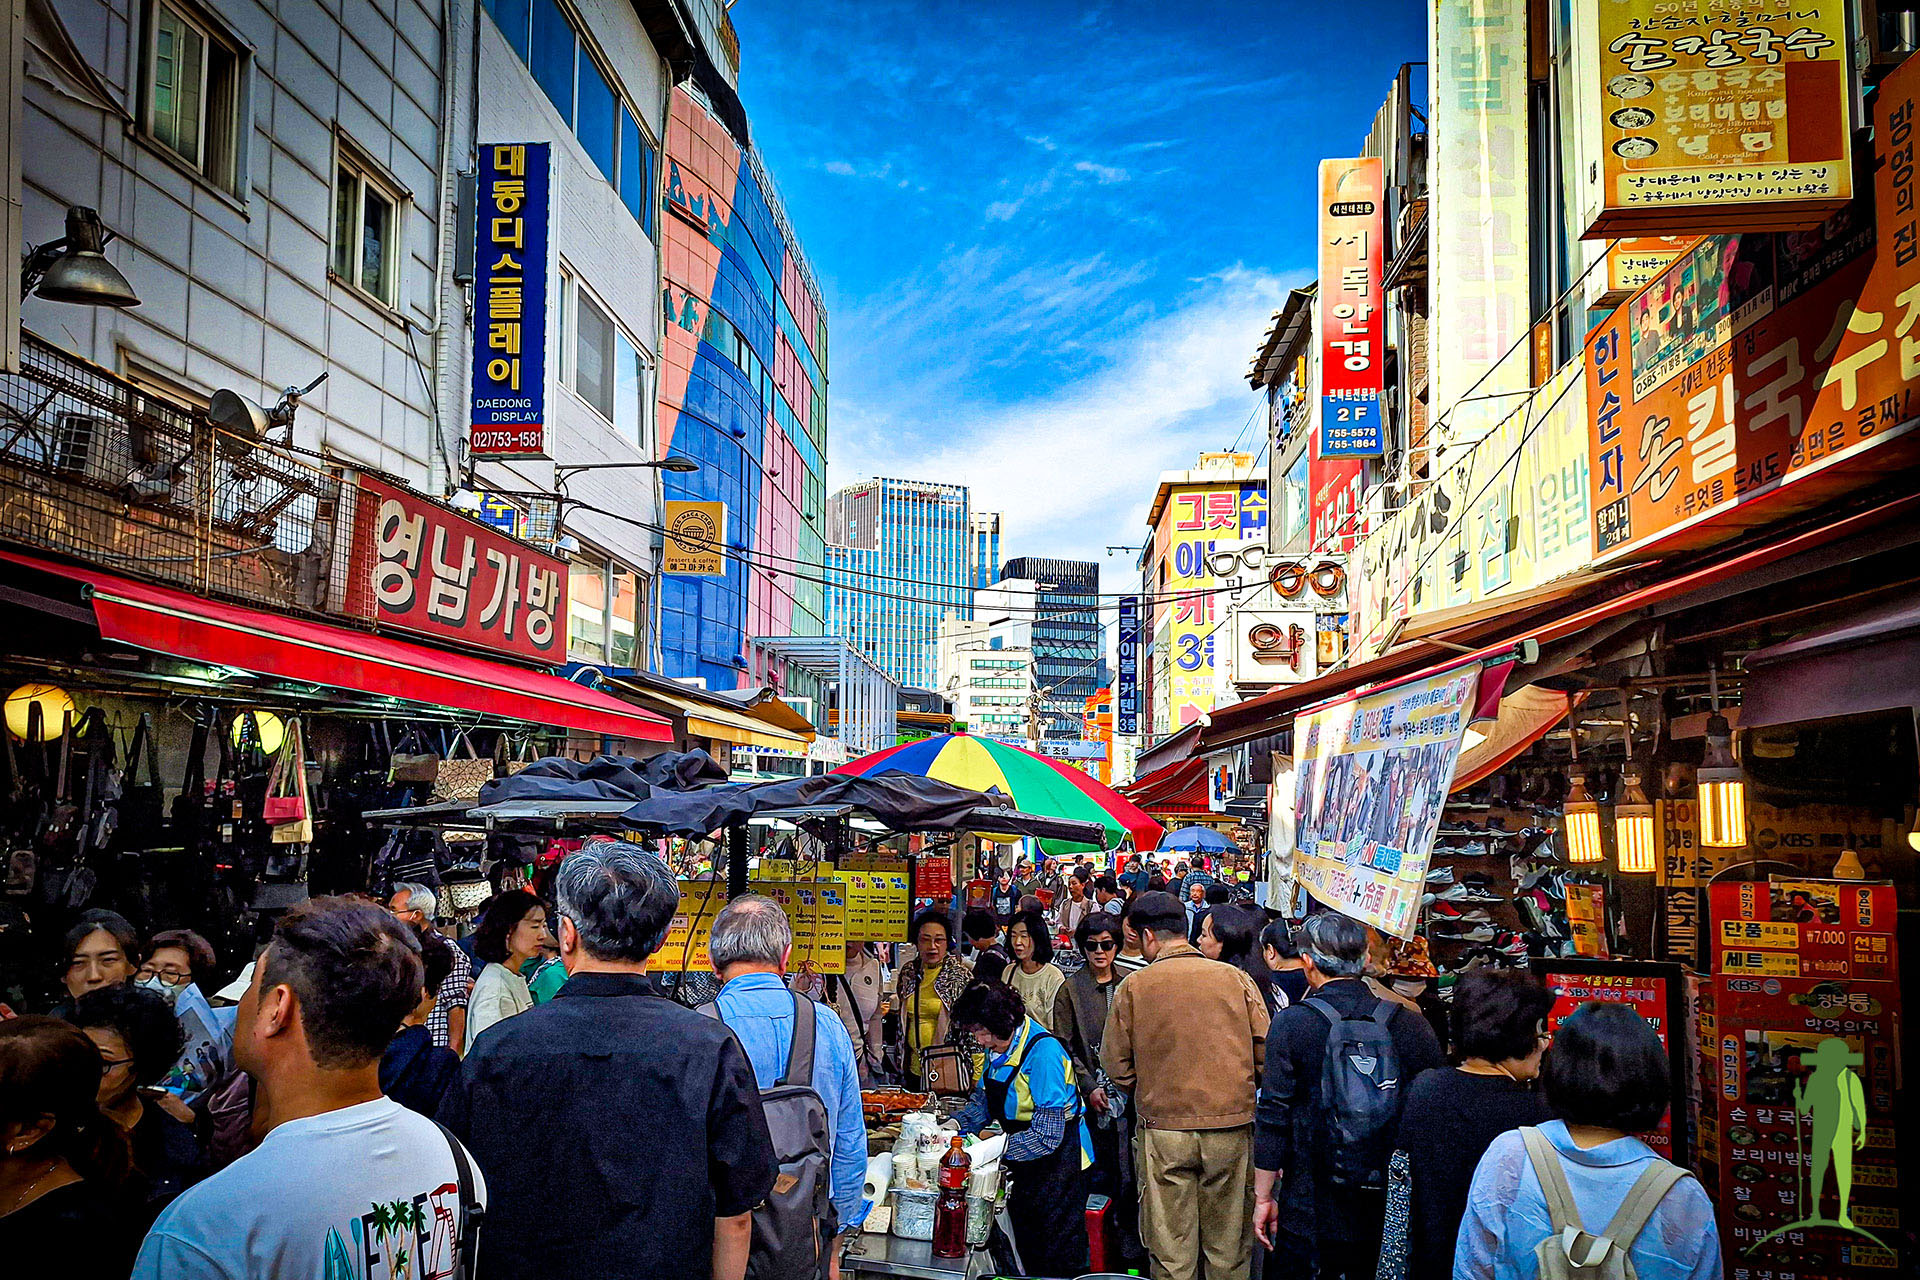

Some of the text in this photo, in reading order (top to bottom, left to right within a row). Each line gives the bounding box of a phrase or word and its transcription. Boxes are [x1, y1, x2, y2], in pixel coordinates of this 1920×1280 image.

[1629, 9, 1820, 30] 한순자할머니
[1609, 27, 1835, 72] 손칼국수
[486, 144, 526, 391] 대동디스플레이
[476, 398, 532, 409] DAEDONG
[1594, 326, 1625, 495] 한순자
[491, 411, 539, 422] DISPLAY
[473, 431, 542, 449] 02)753-1581
[1328, 427, 1377, 438] 755-5578
[1328, 437, 1377, 448] 755-1864
[1789, 421, 1846, 468] 냉면은
[1176, 492, 1237, 530] 그릇
[371, 499, 561, 645] 영남가방
[669, 563, 715, 572] 에그마카슈
[1118, 718, 1137, 732] 3층
[1052, 746, 1069, 755] 조성
[1724, 921, 1762, 938] 단품
[1725, 951, 1763, 968] 세트
[1568, 988, 1590, 997] SBS
[1727, 979, 1762, 993] KBS
[1723, 1038, 1738, 1098] 착한가격
